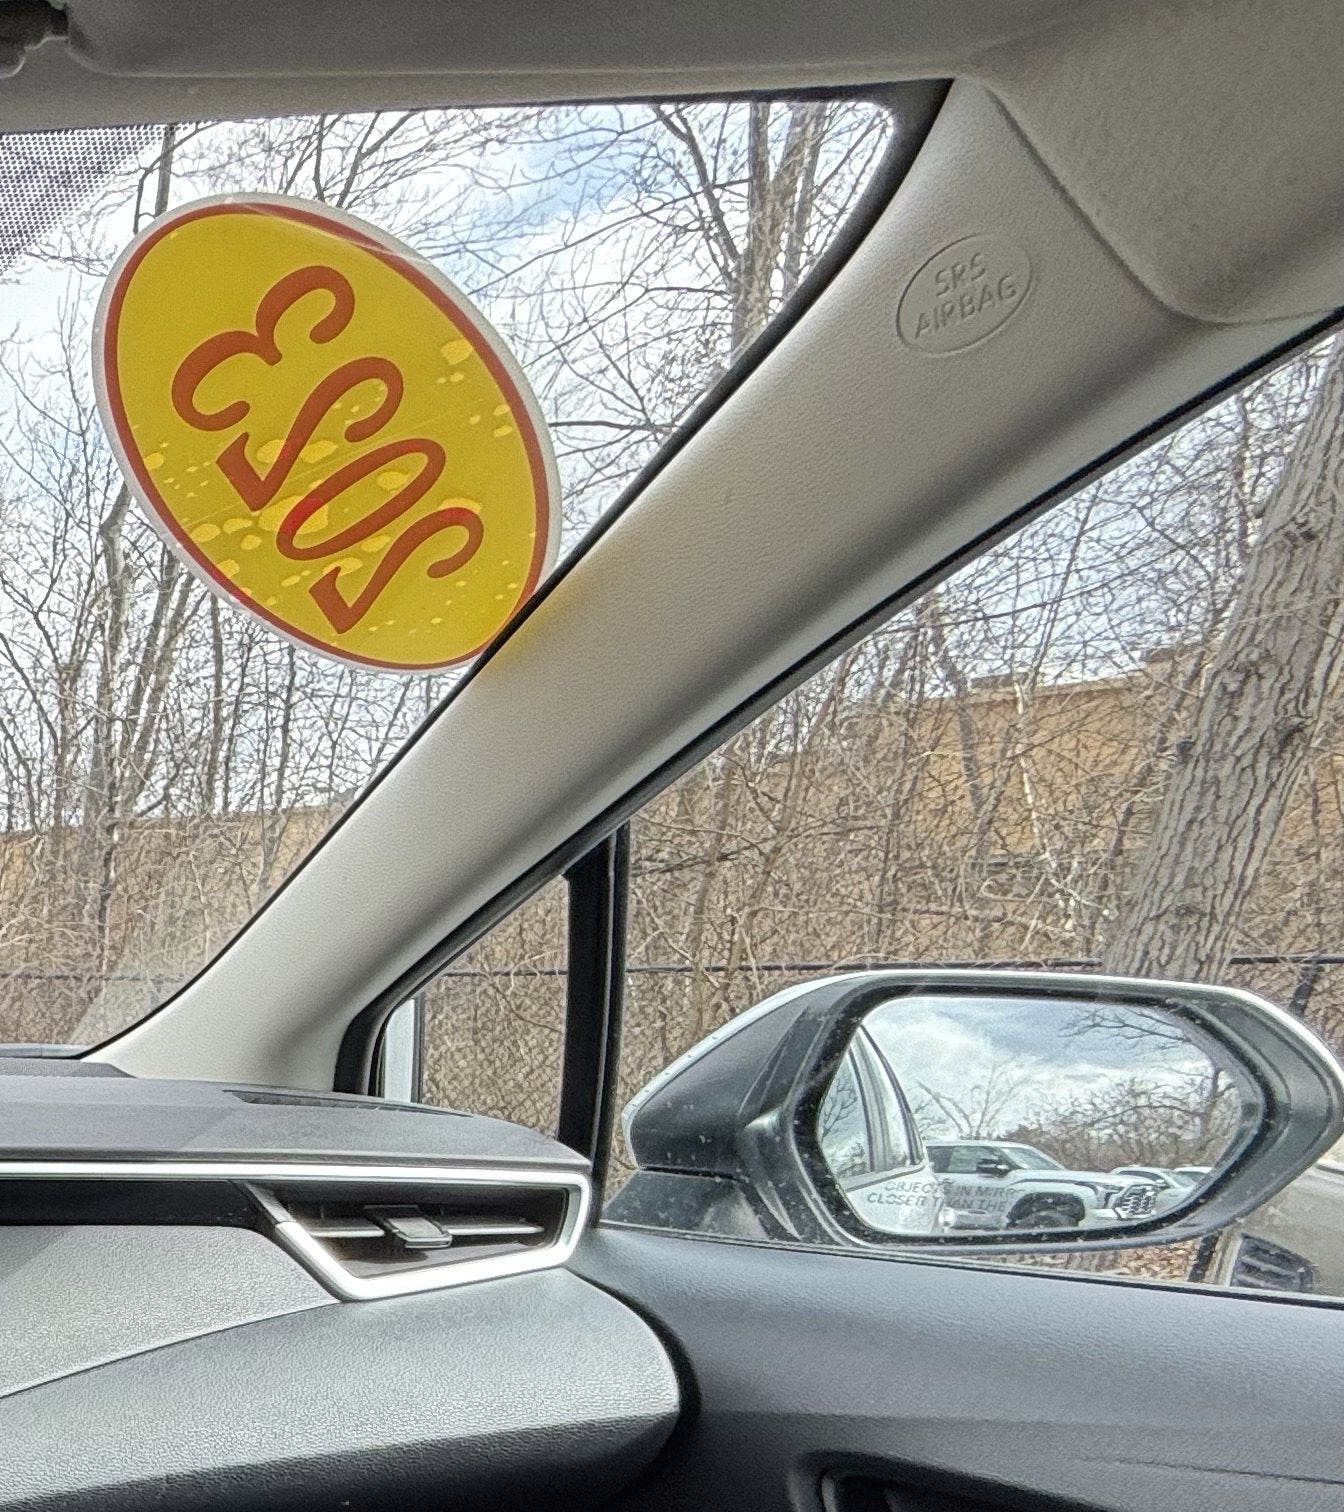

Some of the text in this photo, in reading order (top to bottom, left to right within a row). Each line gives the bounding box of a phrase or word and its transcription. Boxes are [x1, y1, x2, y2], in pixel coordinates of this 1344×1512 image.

[934, 251, 987, 297] SRS
[914, 274, 1017, 340] AIRBAG
[867, 1191, 928, 1207] CLOSER
